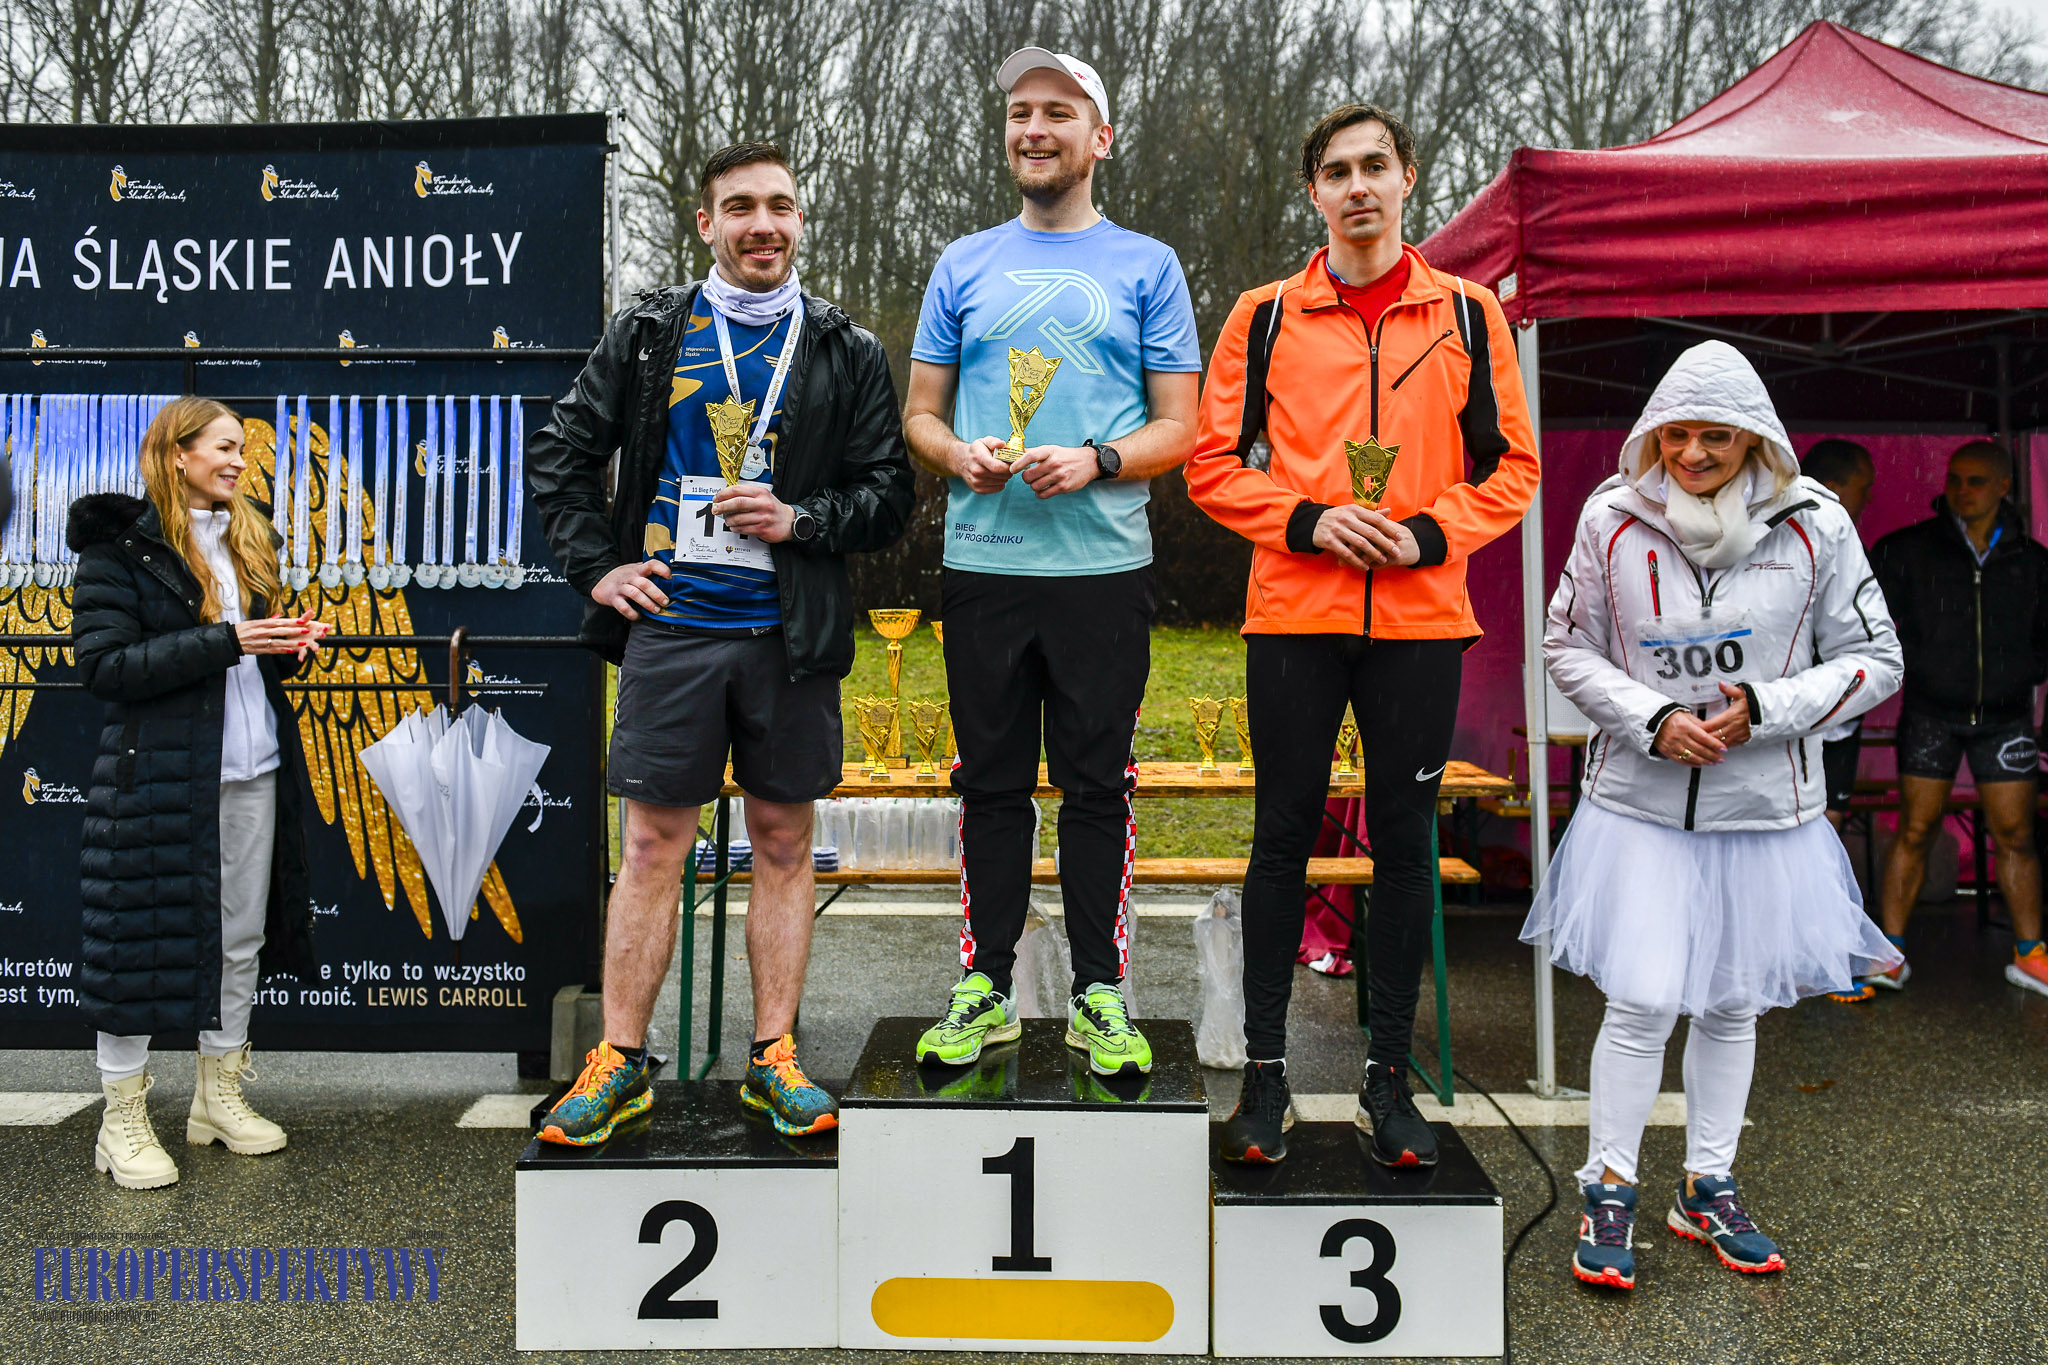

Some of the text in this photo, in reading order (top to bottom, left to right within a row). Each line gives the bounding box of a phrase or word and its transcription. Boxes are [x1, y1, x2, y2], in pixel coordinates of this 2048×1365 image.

[73, 226, 292, 303] ŚLĄSKIE
[324, 231, 523, 290] ANIOŁY
[955, 531, 1024, 544] W ROGOŹNIKU
[1653, 639, 1744, 680] 300
[342, 960, 391, 985] tylko
[401, 963, 423, 981] to
[37, 985, 80, 1008] tym,
[367, 987, 428, 1007] LEWIS
[439, 987, 527, 1007] CARROLL
[982, 1137, 1052, 1272] 1
[637, 1200, 719, 1320] 2
[1319, 1218, 1402, 1343] 3
